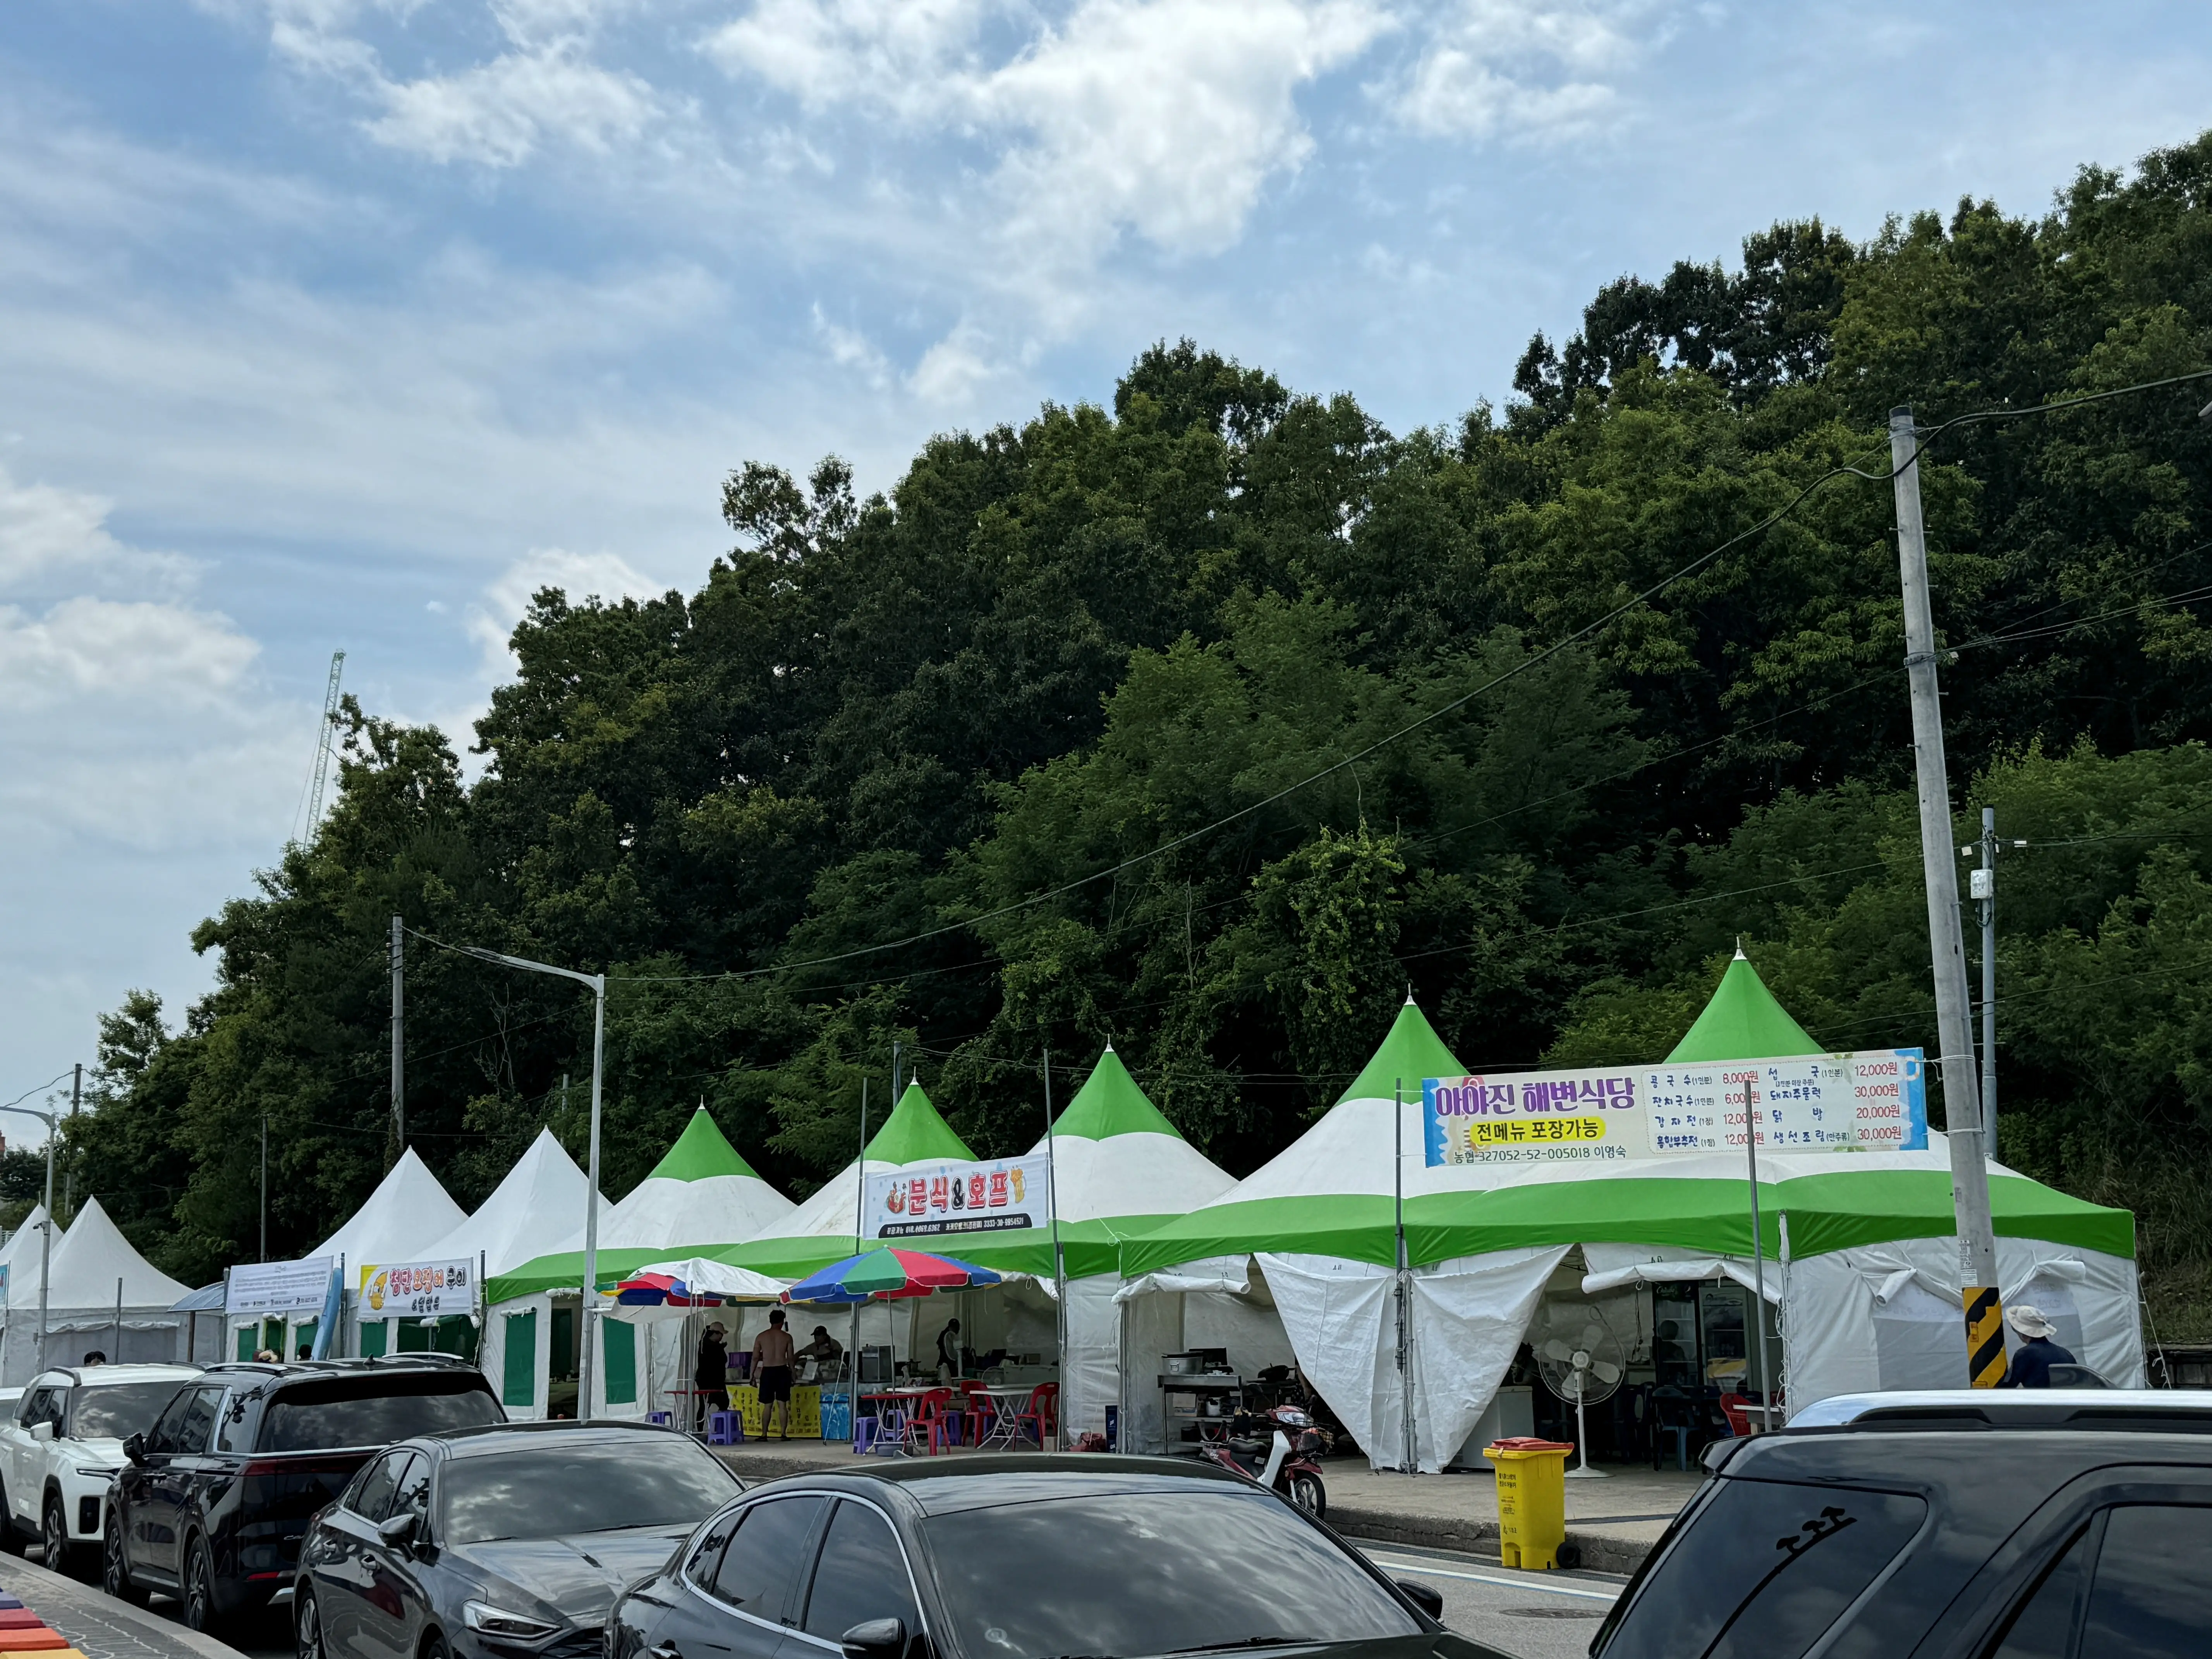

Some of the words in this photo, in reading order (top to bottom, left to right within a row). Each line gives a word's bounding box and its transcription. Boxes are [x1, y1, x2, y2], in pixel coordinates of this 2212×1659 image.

[1723, 1070, 1759, 1085] 8,000원
[1768, 1068, 1778, 1080] 섭
[1811, 1066, 1819, 1079] 국
[1822, 1069, 1843, 1078] (1인분)
[1855, 1062, 1897, 1078] 12,000원
[1436, 1084, 1515, 1116] 아야진
[1522, 1077, 1635, 1112] 해변식당
[1725, 1091, 1760, 1105] 6,00원
[1770, 1087, 1821, 1101] 돼지주물럭
[1855, 1083, 1899, 1099] 30,000원
[1724, 1111, 1763, 1126] 12,00원
[1772, 1109, 1782, 1123] 닭
[1812, 1108, 1822, 1121] 발
[1856, 1104, 1900, 1120] 20,000원
[1477, 1123, 1525, 1142] 전메뉴
[1531, 1118, 1598, 1140] 포장가능
[1857, 1126, 1902, 1141] 30,000원
[1657, 1135, 1698, 1149] 홍합부추전
[1725, 1132, 1764, 1146] 12,00원
[1454, 1149, 1475, 1164] 농협
[1479, 1147, 1590, 1162] 327052-52-005018
[1594, 1145, 1626, 1159] 이영숙
[412, 1266, 443, 1294] 오징어
[446, 1266, 467, 1290] 구이
